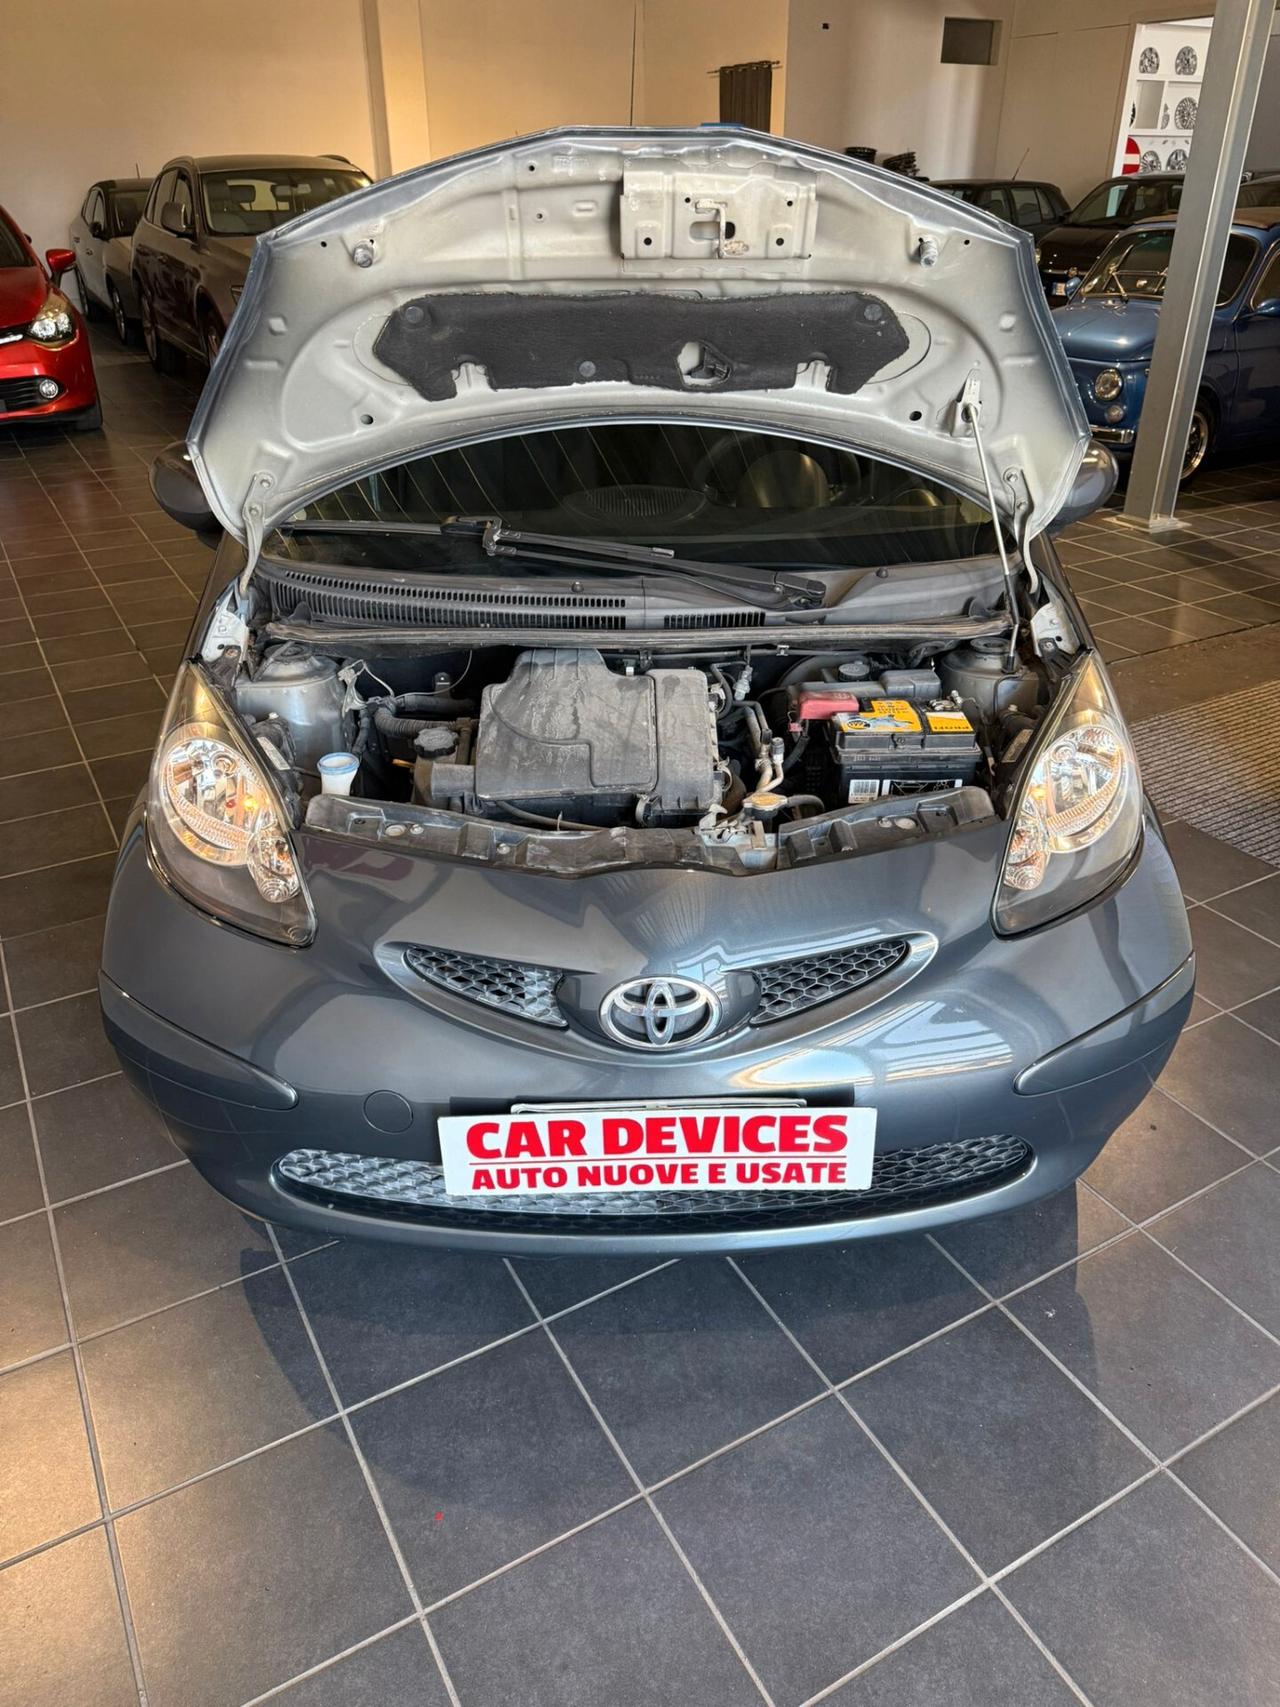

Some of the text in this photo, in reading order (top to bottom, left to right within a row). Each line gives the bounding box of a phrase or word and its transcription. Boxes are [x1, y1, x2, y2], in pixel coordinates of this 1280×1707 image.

[466, 1115, 848, 1159] CAR DEVICES
[472, 1162, 847, 1190] AUTO NUOVE E USATE
